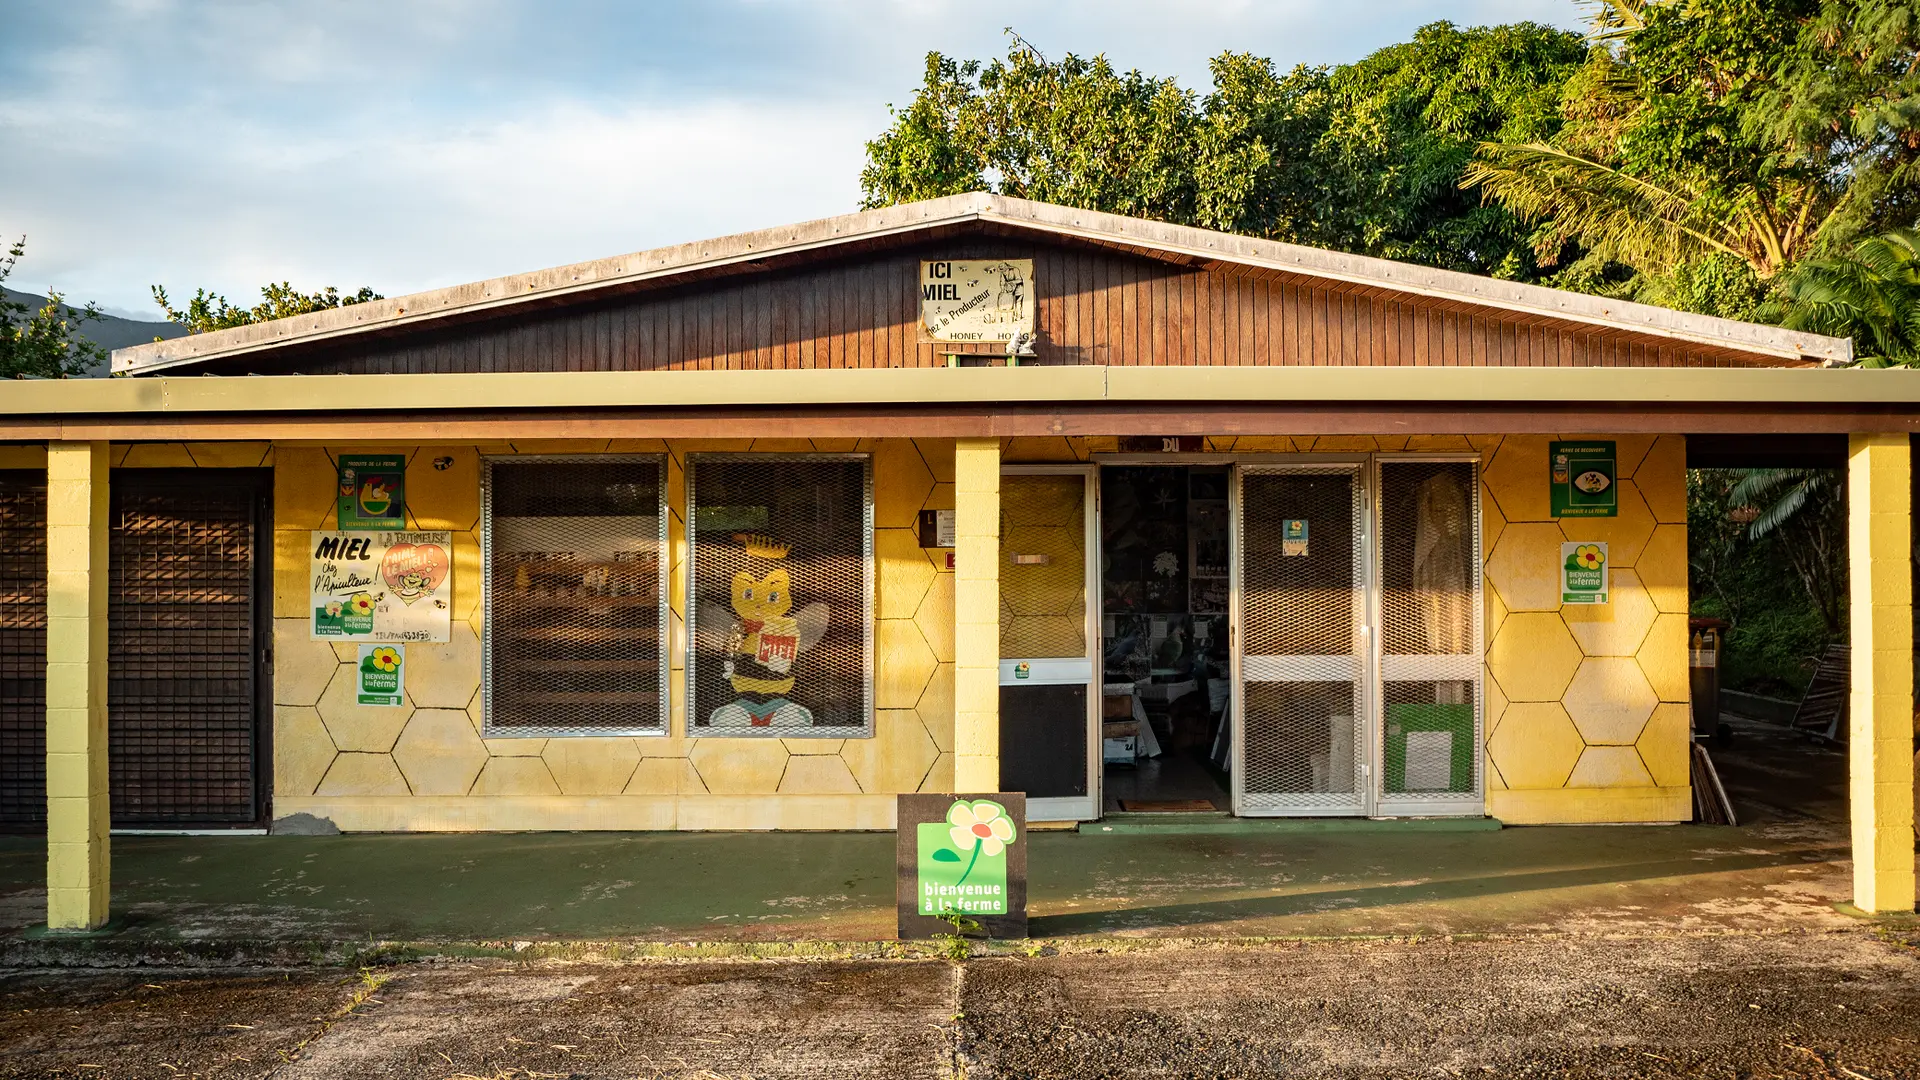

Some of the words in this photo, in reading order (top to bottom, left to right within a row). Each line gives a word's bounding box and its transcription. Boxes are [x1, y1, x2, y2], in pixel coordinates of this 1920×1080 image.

[929, 262, 952, 279] ICI
[940, 317, 950, 327] le
[948, 289, 991, 320] Producteur
[950, 332, 984, 340] HONEY
[1162, 437, 1179, 452] DU
[315, 537, 371, 561] MIEL
[1577, 577, 1601, 586] ferme
[373, 679, 396, 687] ferme
[924, 881, 1001, 896] bienvenue
[924, 897, 933, 911] à
[957, 897, 1001, 911] ferme
